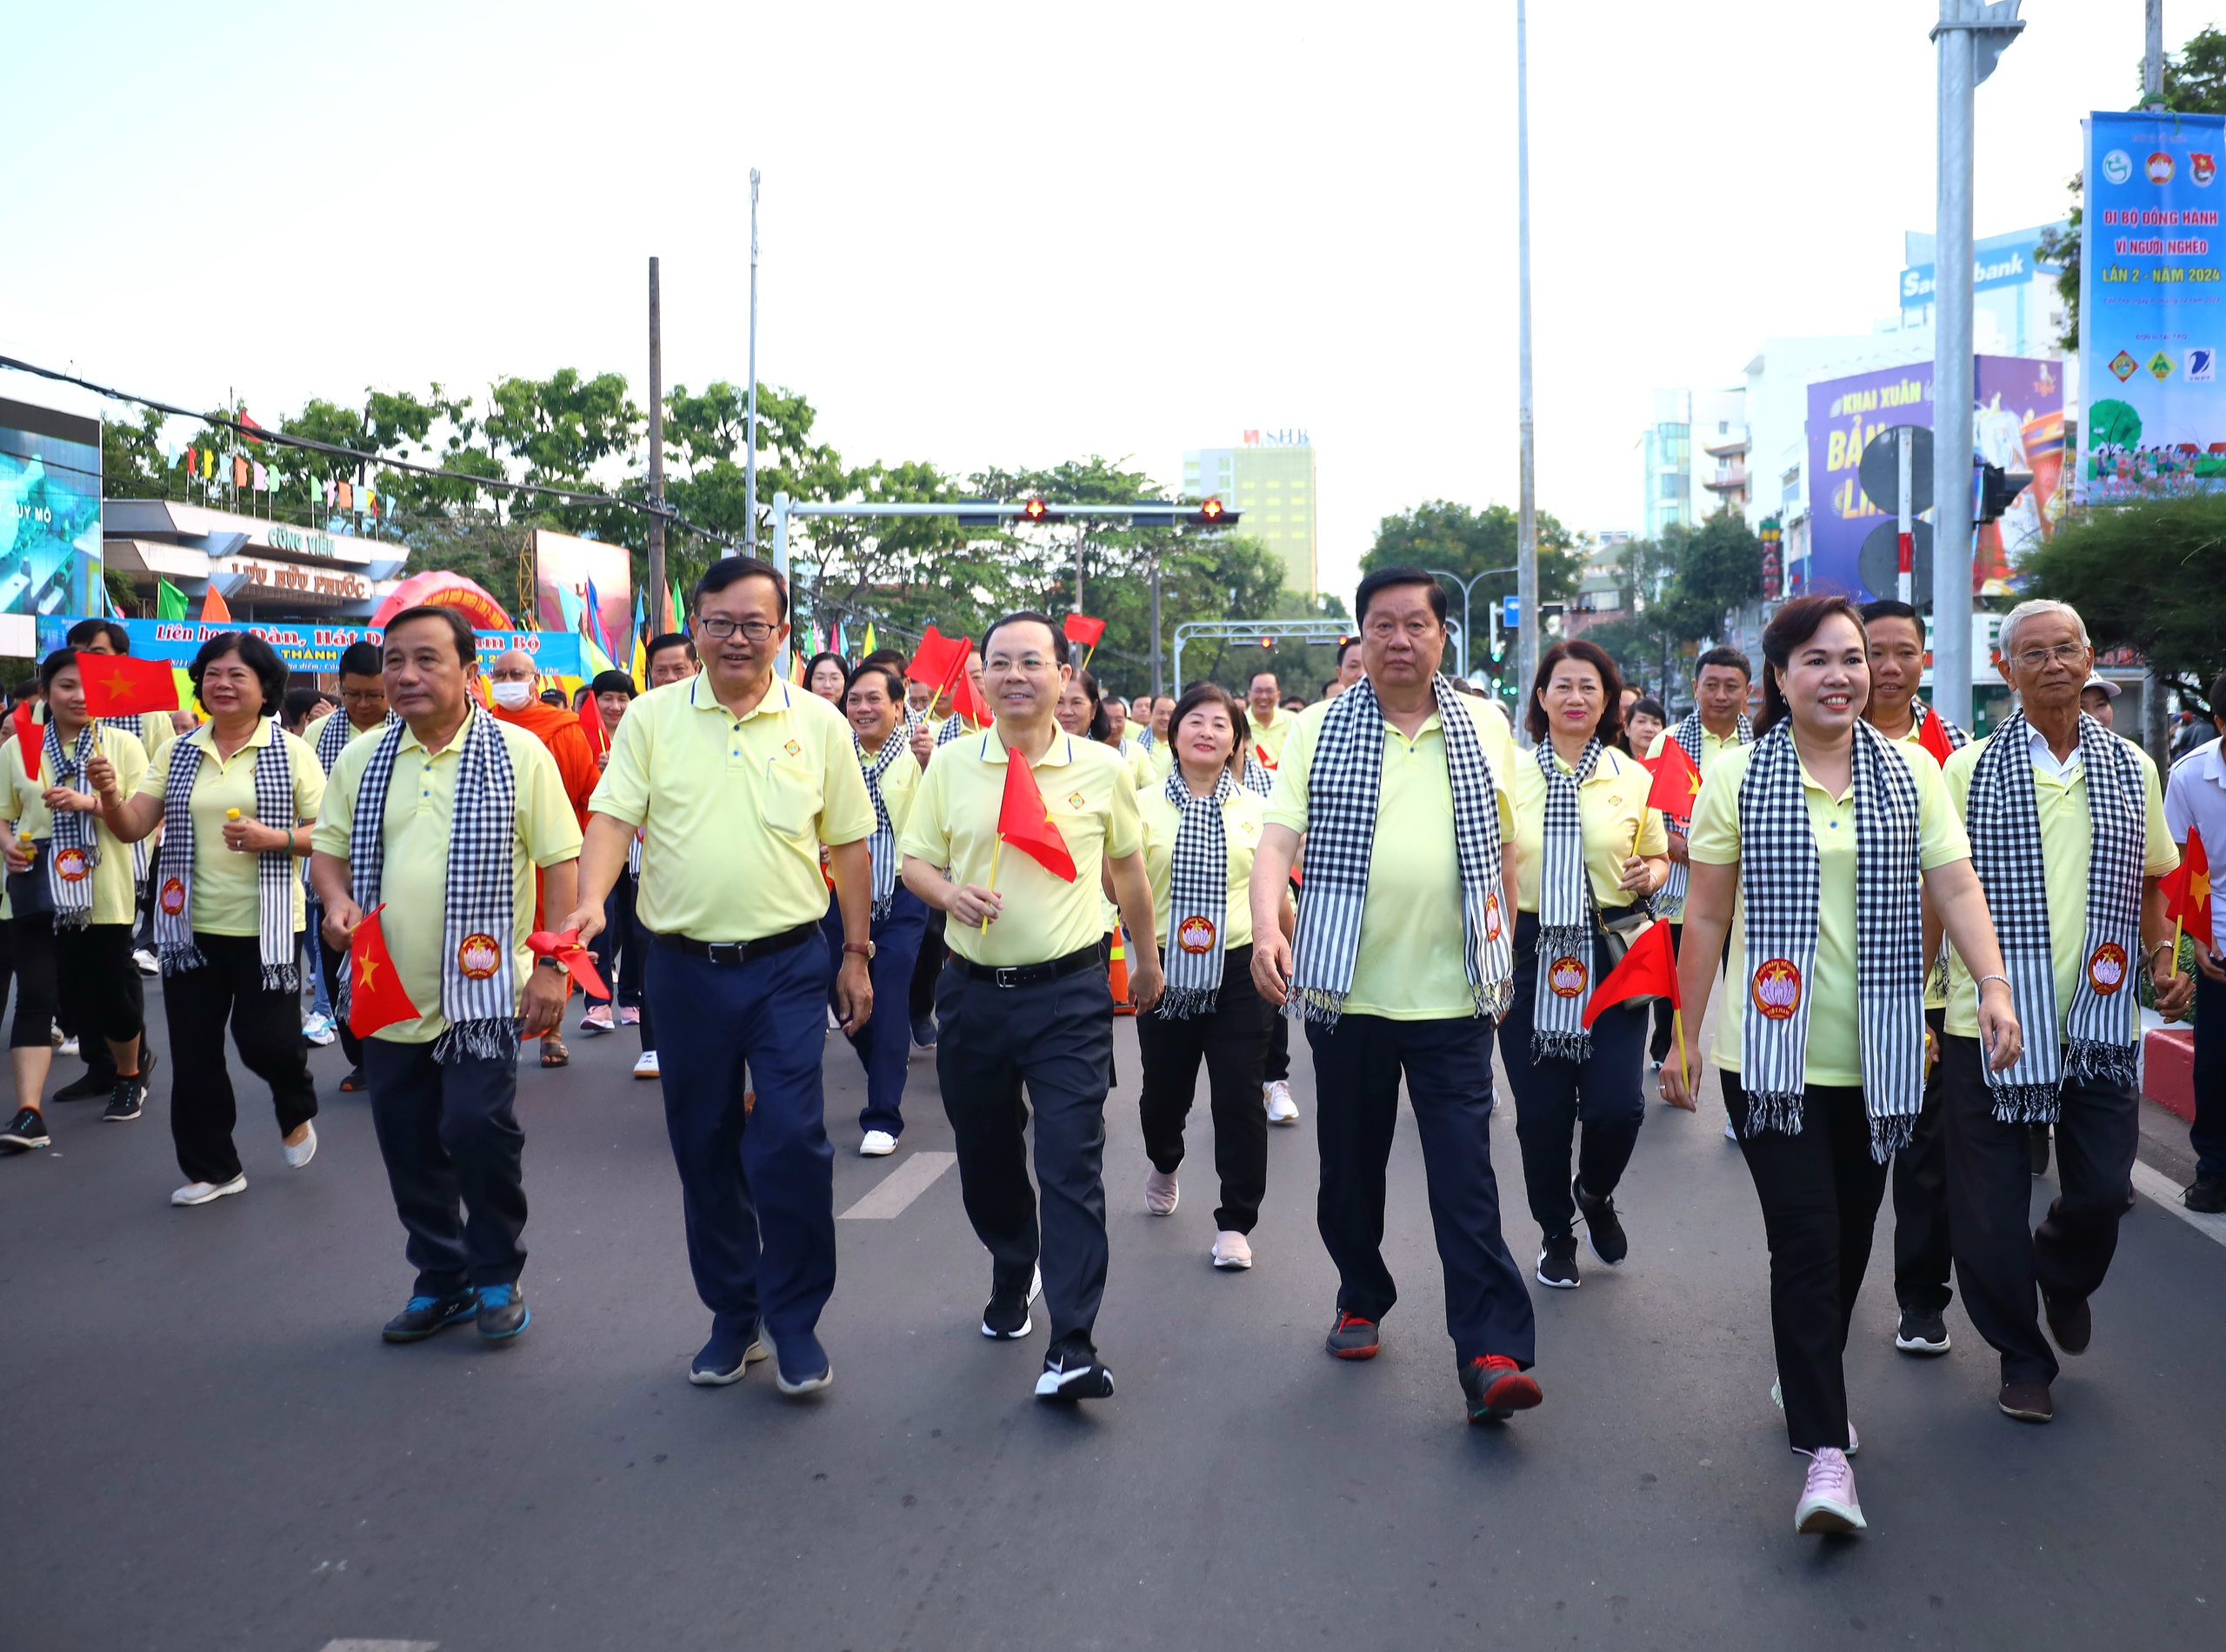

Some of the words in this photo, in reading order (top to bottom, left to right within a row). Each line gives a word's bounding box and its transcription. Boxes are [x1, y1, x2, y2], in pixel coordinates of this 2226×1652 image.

[2104, 210, 2117, 225] ĐI
[2131, 268, 2140, 283] 2
[2152, 266, 2184, 283] NĂM
[2189, 268, 2221, 283] 2024
[1843, 390, 1878, 416] KHAI
[1880, 377, 1922, 409] XUÂN
[268, 524, 303, 552] CÔNG
[307, 532, 336, 558] VIÊN
[275, 564, 309, 590] HỮU
[314, 573, 365, 598] PHƯỚC
[156, 623, 194, 642] Liên
[511, 634, 541, 655] Bộ
